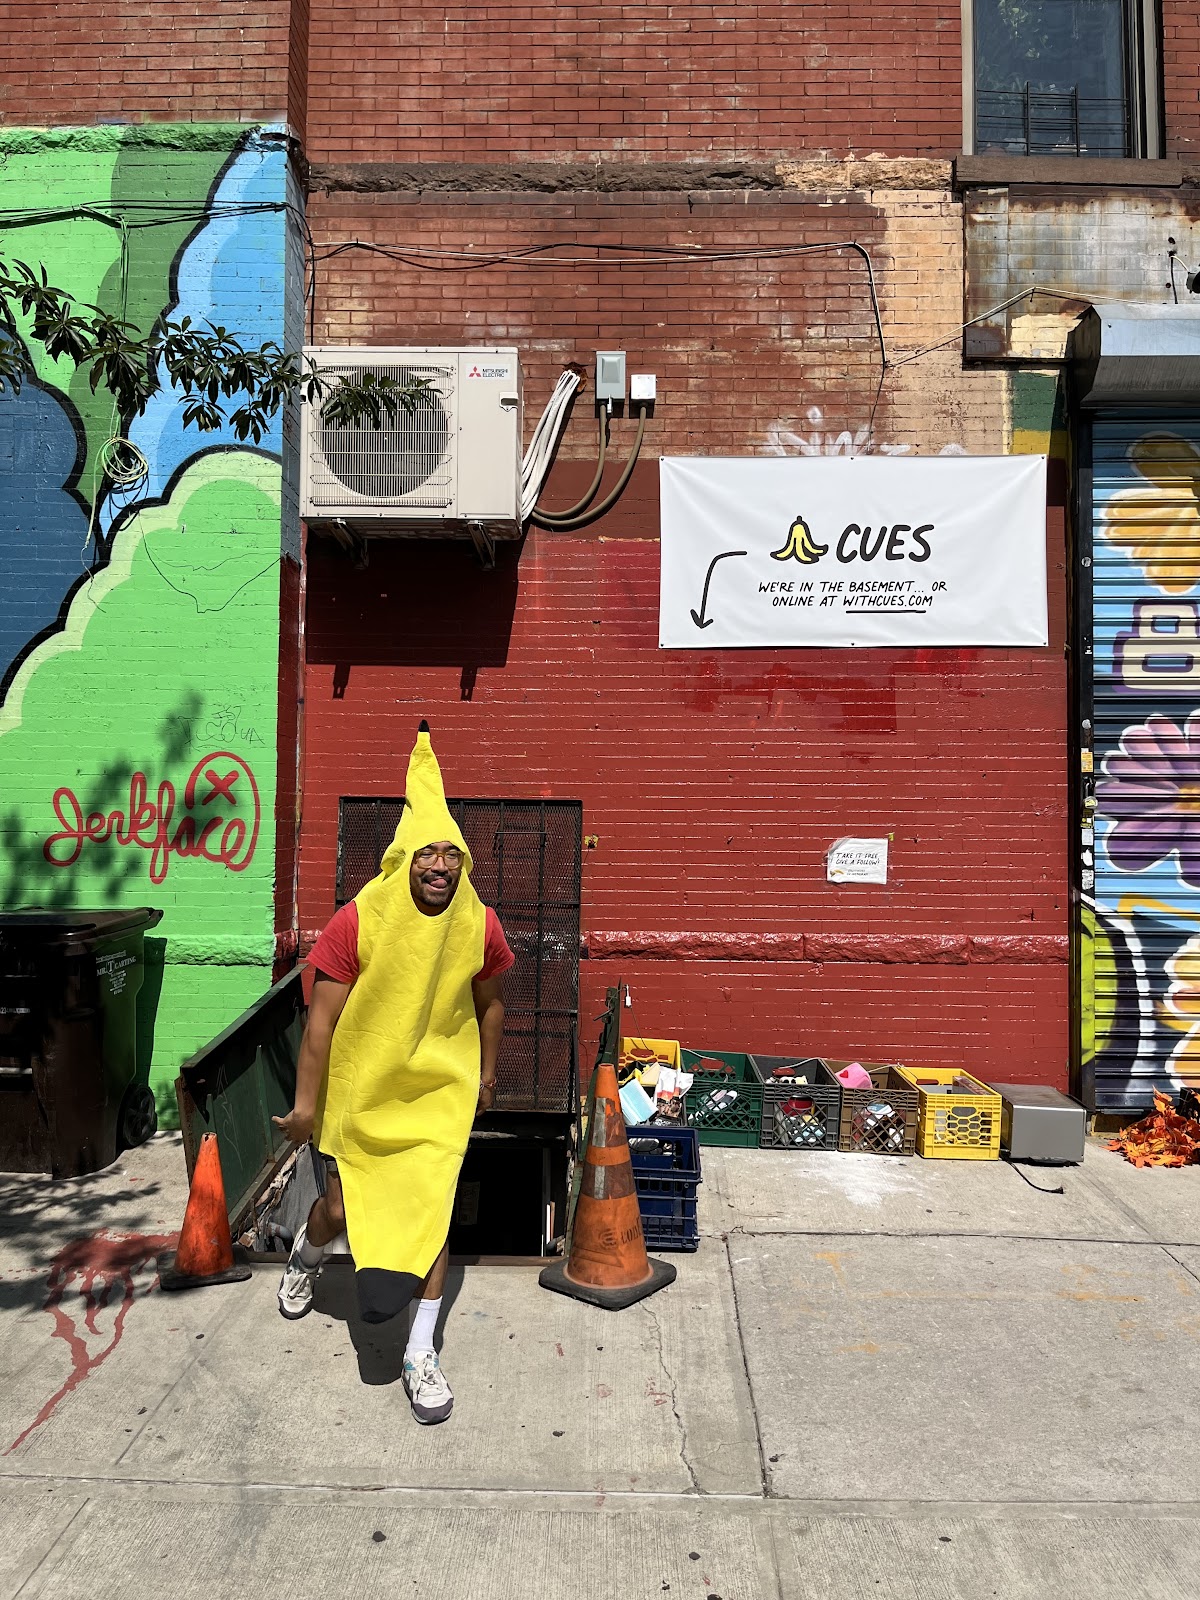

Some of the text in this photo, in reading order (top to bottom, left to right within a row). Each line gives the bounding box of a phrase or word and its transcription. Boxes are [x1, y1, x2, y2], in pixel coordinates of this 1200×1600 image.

[836, 523, 935, 564] CUES
[758, 580, 948, 593] WE'RE IN THE BASEMENT... OR
[772, 594, 934, 607] ONLINE AT WITHCUES.COM
[42, 750, 261, 885] Jerkface
[114, 955, 136, 968] CARTING
